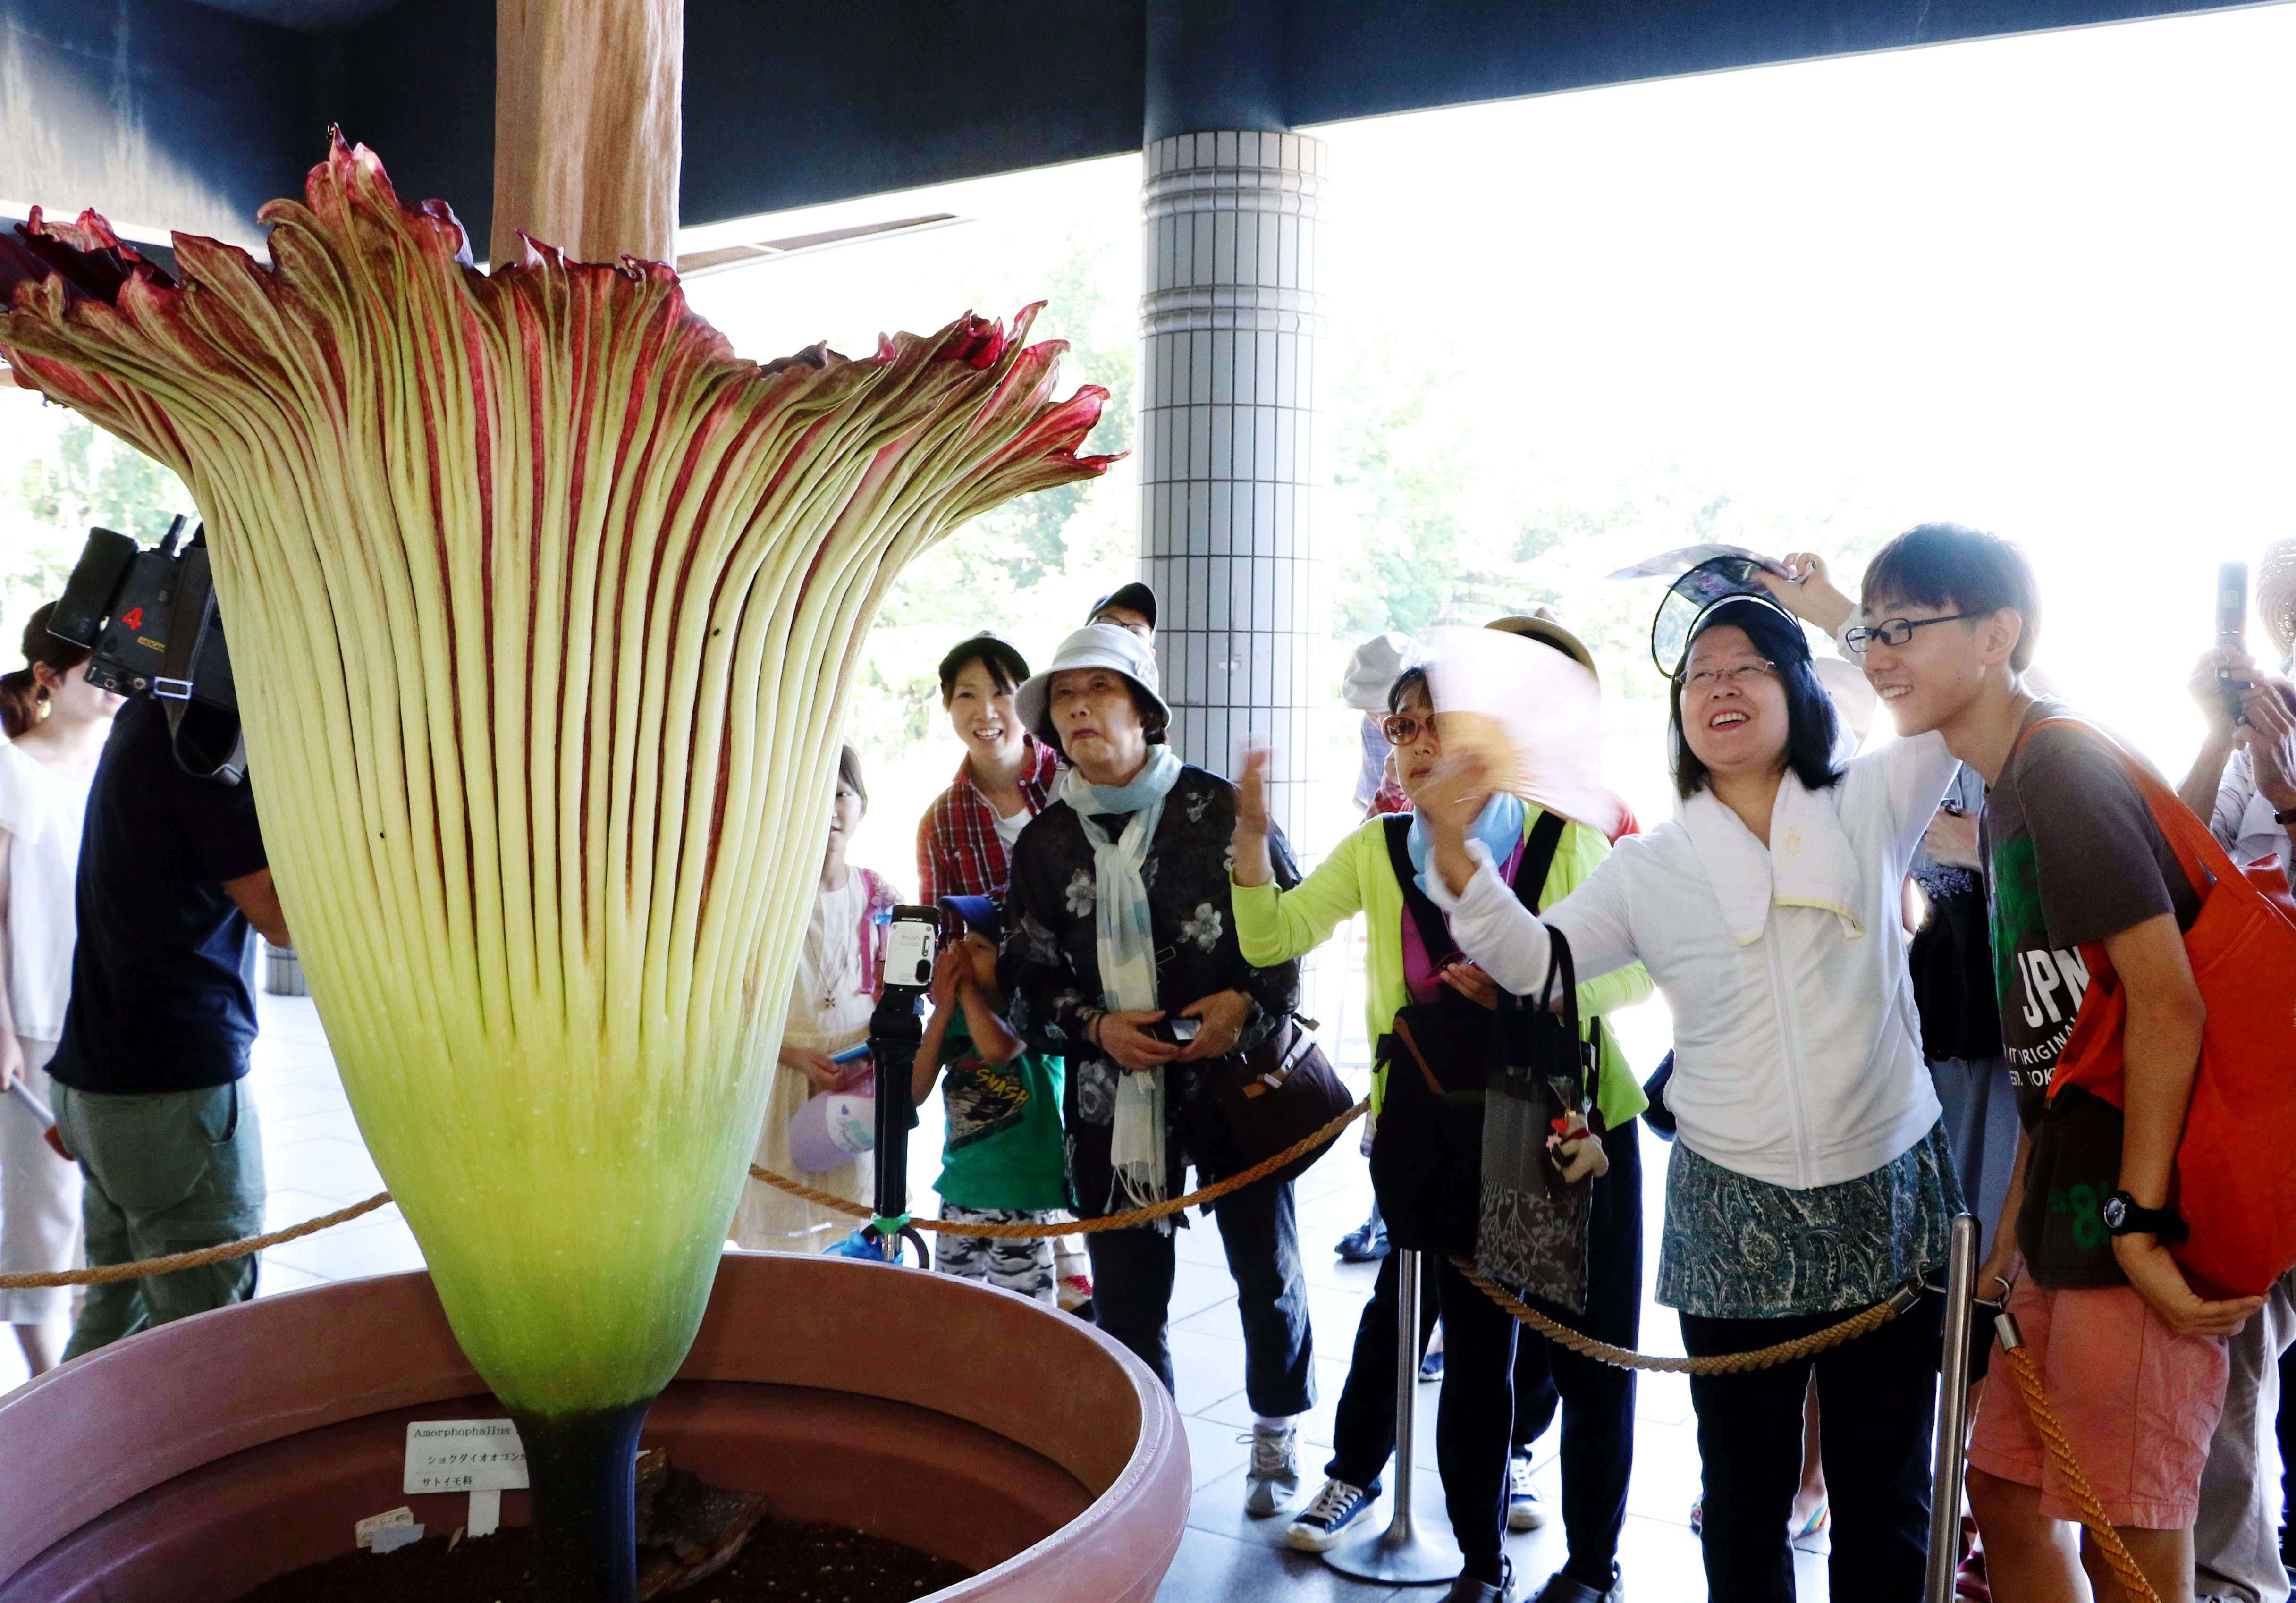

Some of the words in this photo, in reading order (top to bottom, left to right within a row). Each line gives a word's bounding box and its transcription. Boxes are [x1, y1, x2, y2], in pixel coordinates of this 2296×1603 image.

[122, 607, 144, 631] 4
[2018, 945, 2090, 1028] JPN
[2018, 1016, 2076, 1065] RIGINA
[975, 1068, 1030, 1106] SMASH
[414, 1425, 511, 1438] Amorphophallus
[422, 1474, 473, 1487] サトイモ科
